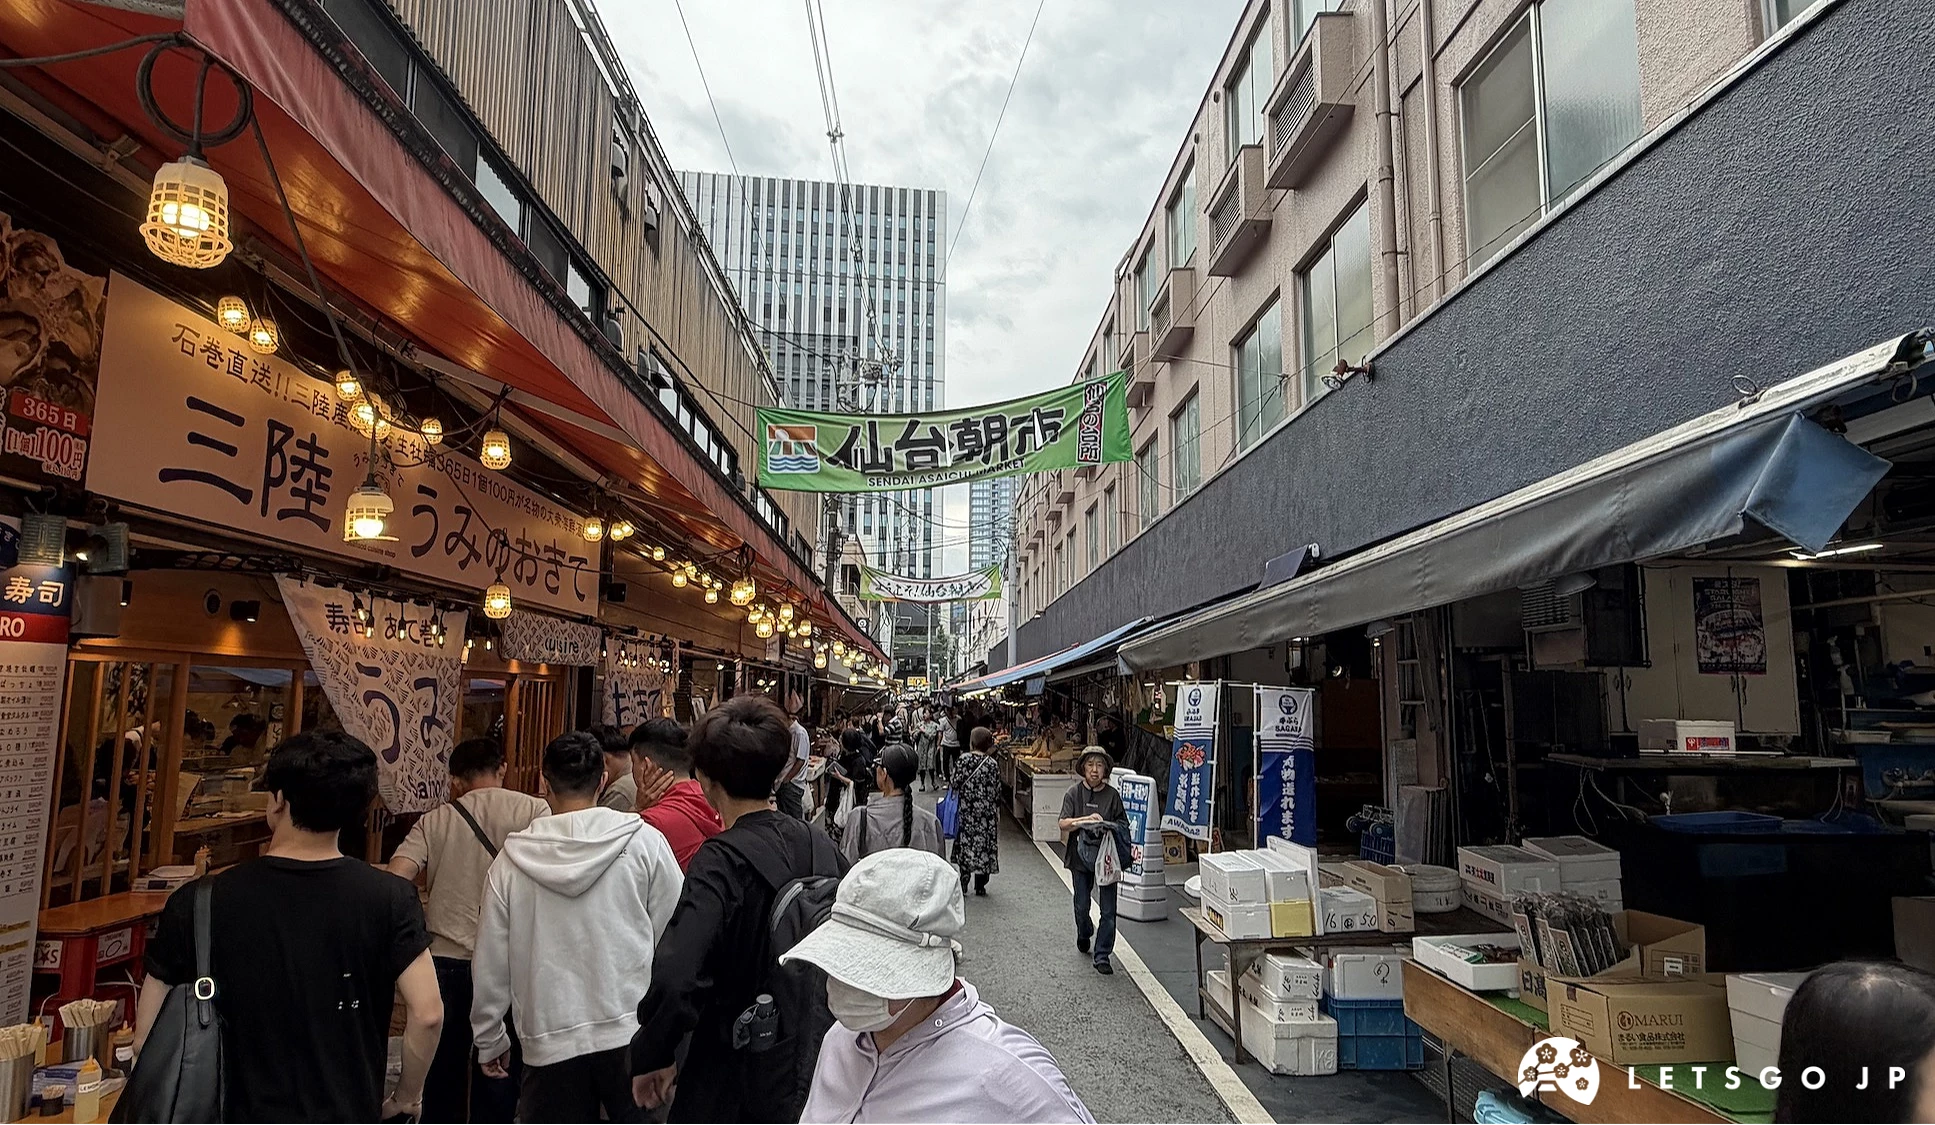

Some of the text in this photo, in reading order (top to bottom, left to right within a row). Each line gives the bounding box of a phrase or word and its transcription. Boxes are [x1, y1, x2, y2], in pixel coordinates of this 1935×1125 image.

[23, 398, 77, 430] 365日
[1079, 382, 1106, 462] 仙台の台所
[825, 407, 1064, 474] 仙台朝市
[868, 476, 914, 487] SENDAI
[159, 396, 589, 602] 三陸 うみのおきて
[4, 575, 64, 607] 寿司
[1635, 1014, 1684, 1027] MARUI
